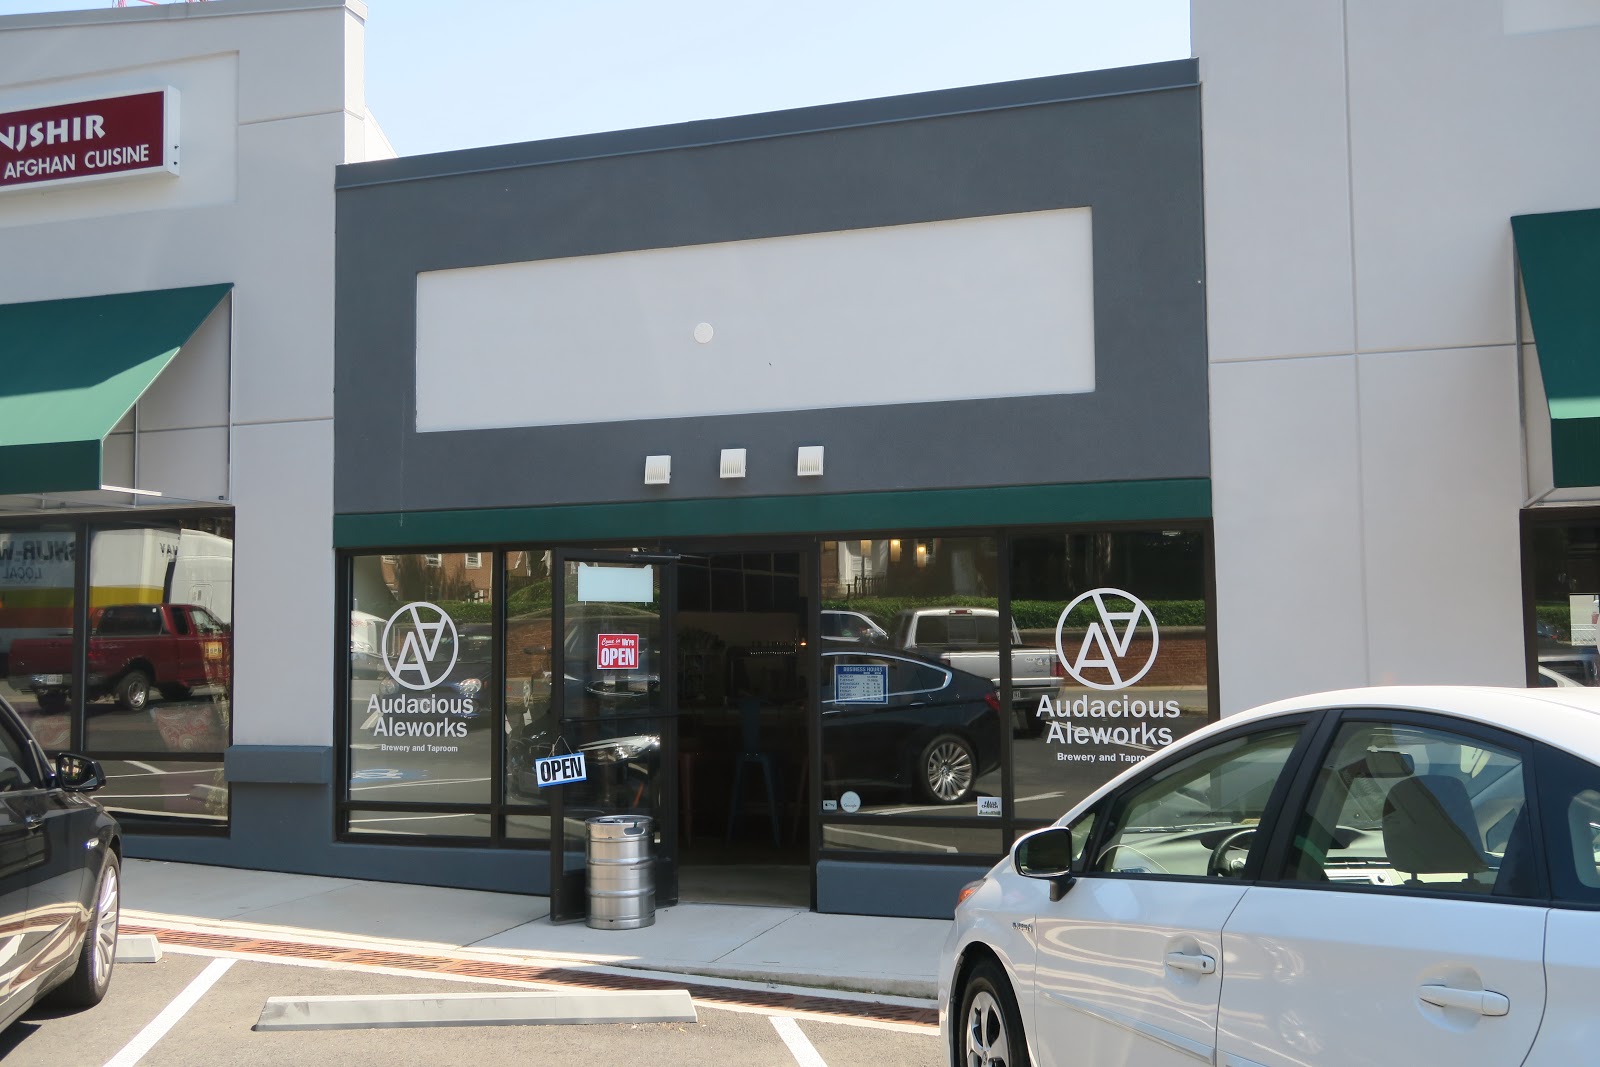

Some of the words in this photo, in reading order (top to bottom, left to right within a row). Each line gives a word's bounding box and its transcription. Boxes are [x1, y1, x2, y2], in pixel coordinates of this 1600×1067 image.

[4, 153, 76, 179] AFGHAN
[84, 143, 150, 169] CUISINE
[601, 647, 634, 666] OPEN
[366, 693, 474, 714] Audacious
[1036, 694, 1181, 718] Audacious
[373, 717, 468, 738] Aleworks
[1046, 721, 1173, 745] Aleworks
[381, 743, 410, 753] Brewery
[411, 744, 425, 752] and
[427, 744, 458, 754] Taproom
[1057, 752, 1096, 762] Brewery
[1099, 753, 1116, 761] and
[1119, 753, 1149, 762] Tapro
[540, 757, 582, 782] OPEN
